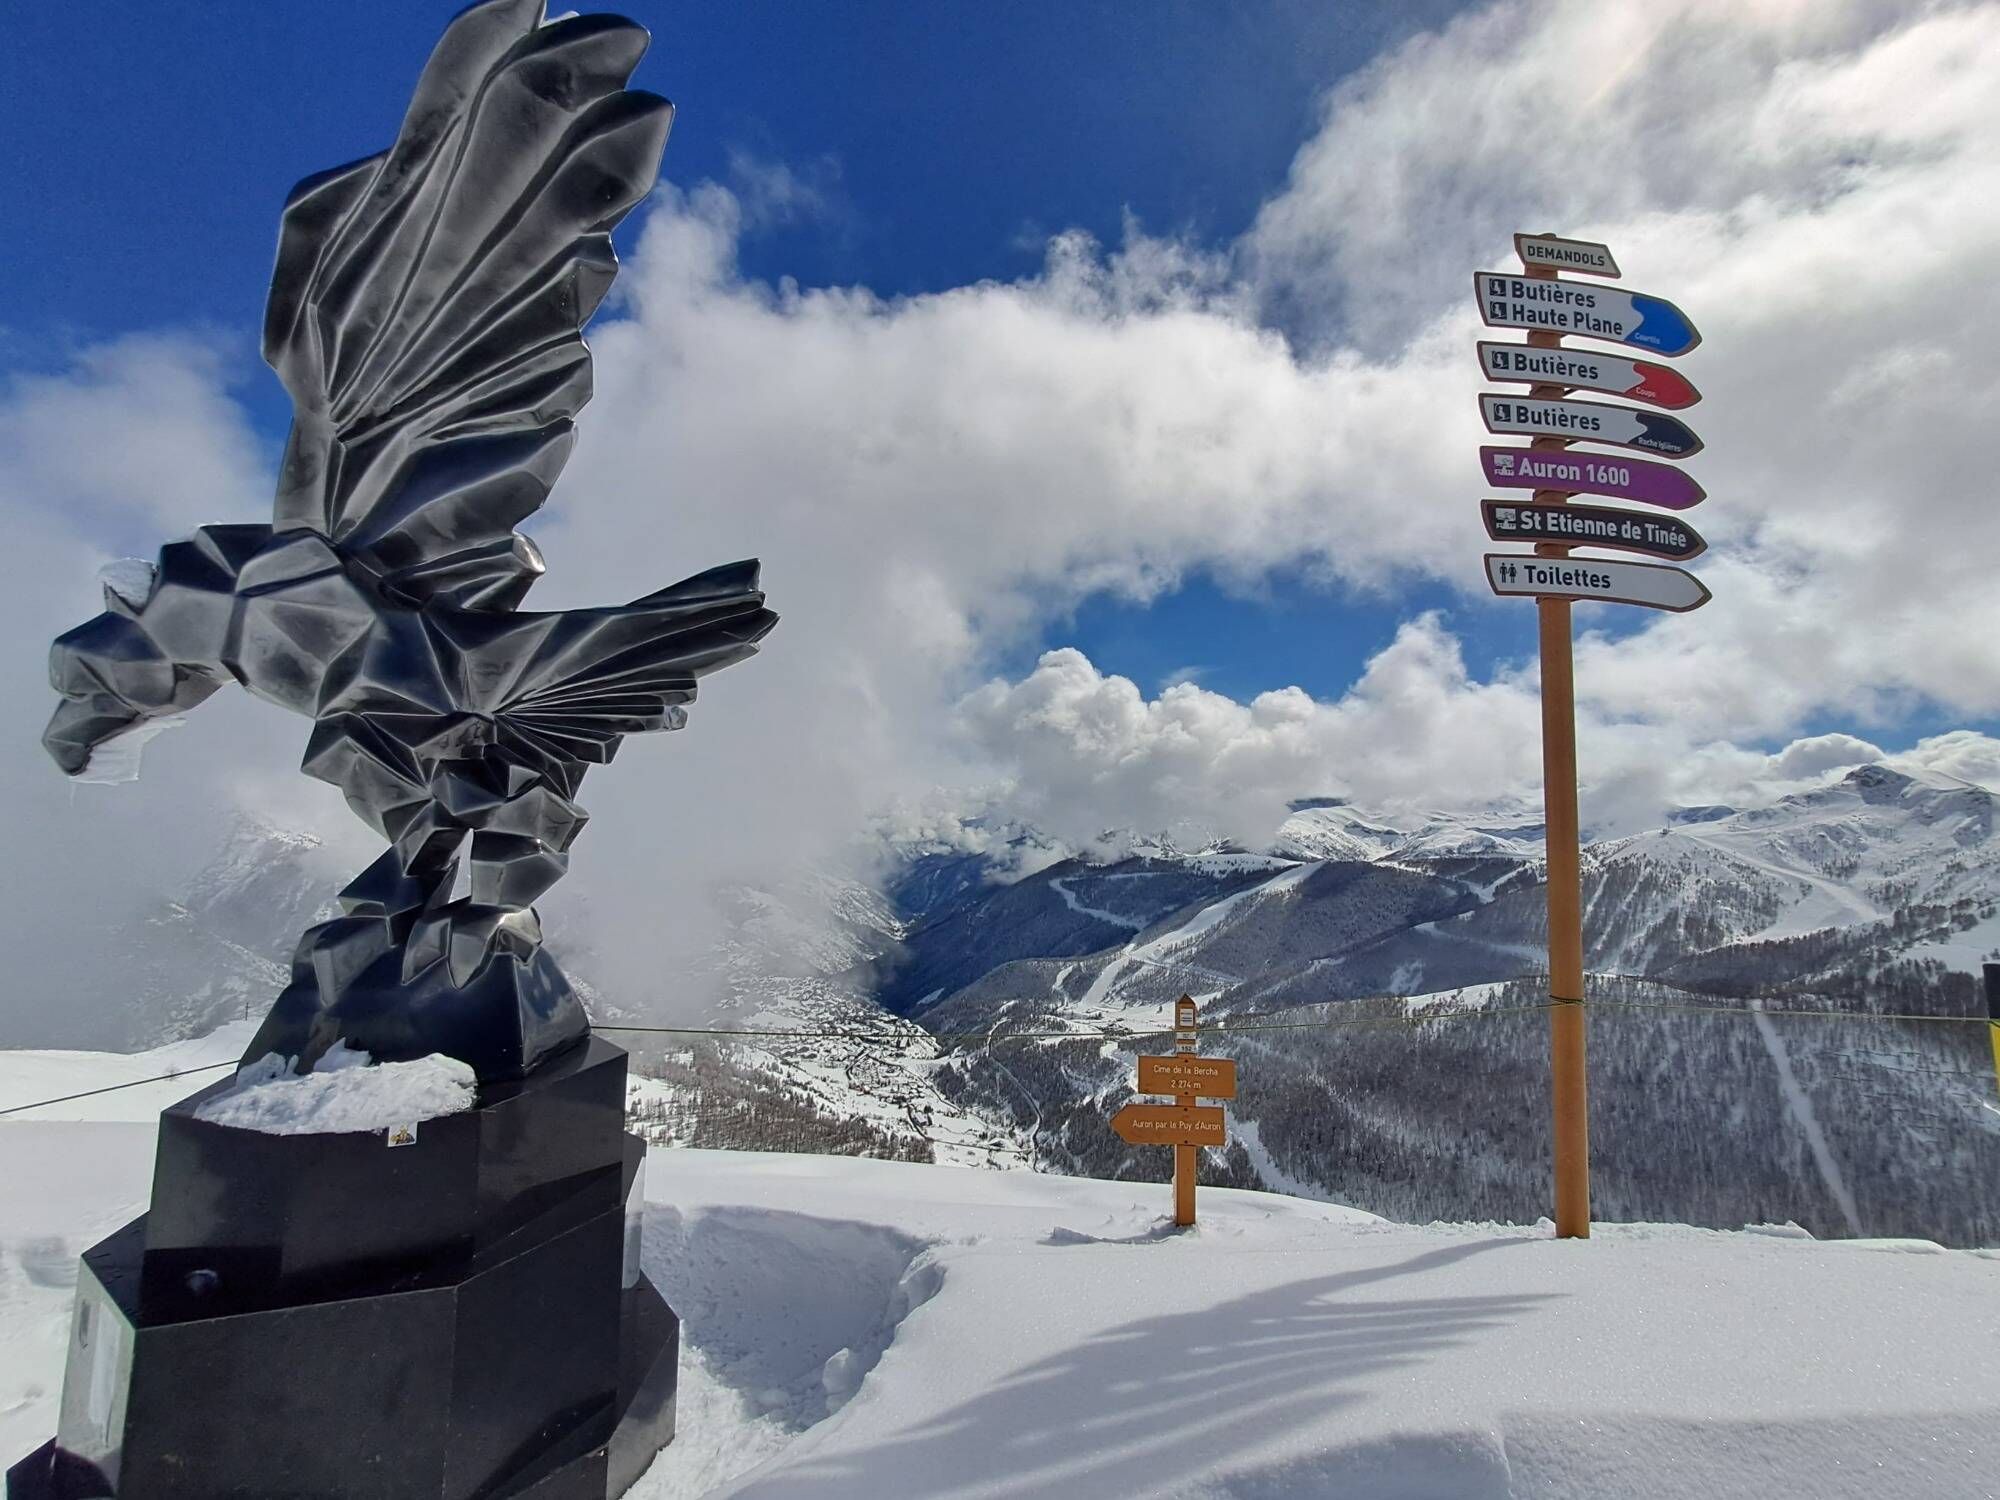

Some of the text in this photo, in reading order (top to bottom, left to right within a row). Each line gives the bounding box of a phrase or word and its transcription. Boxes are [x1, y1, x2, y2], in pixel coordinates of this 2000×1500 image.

[1527, 245, 1605, 266] DEMANDOLS
[1511, 280, 1596, 308] Butières
[1512, 303, 1623, 335] Haute Plane
[1514, 353, 1599, 380] Butières
[1516, 405, 1600, 431] Butières
[1519, 457, 1630, 487] Auron 1600
[1520, 510, 1687, 548] St Etienne de Tinée
[1524, 565, 1611, 589] Toilettes
[1153, 1064, 1218, 1076] Cime de la Bercha
[1178, 1079, 1191, 1089] 274
[1132, 1119, 1221, 1131] Auron par le Puy d'Auron
